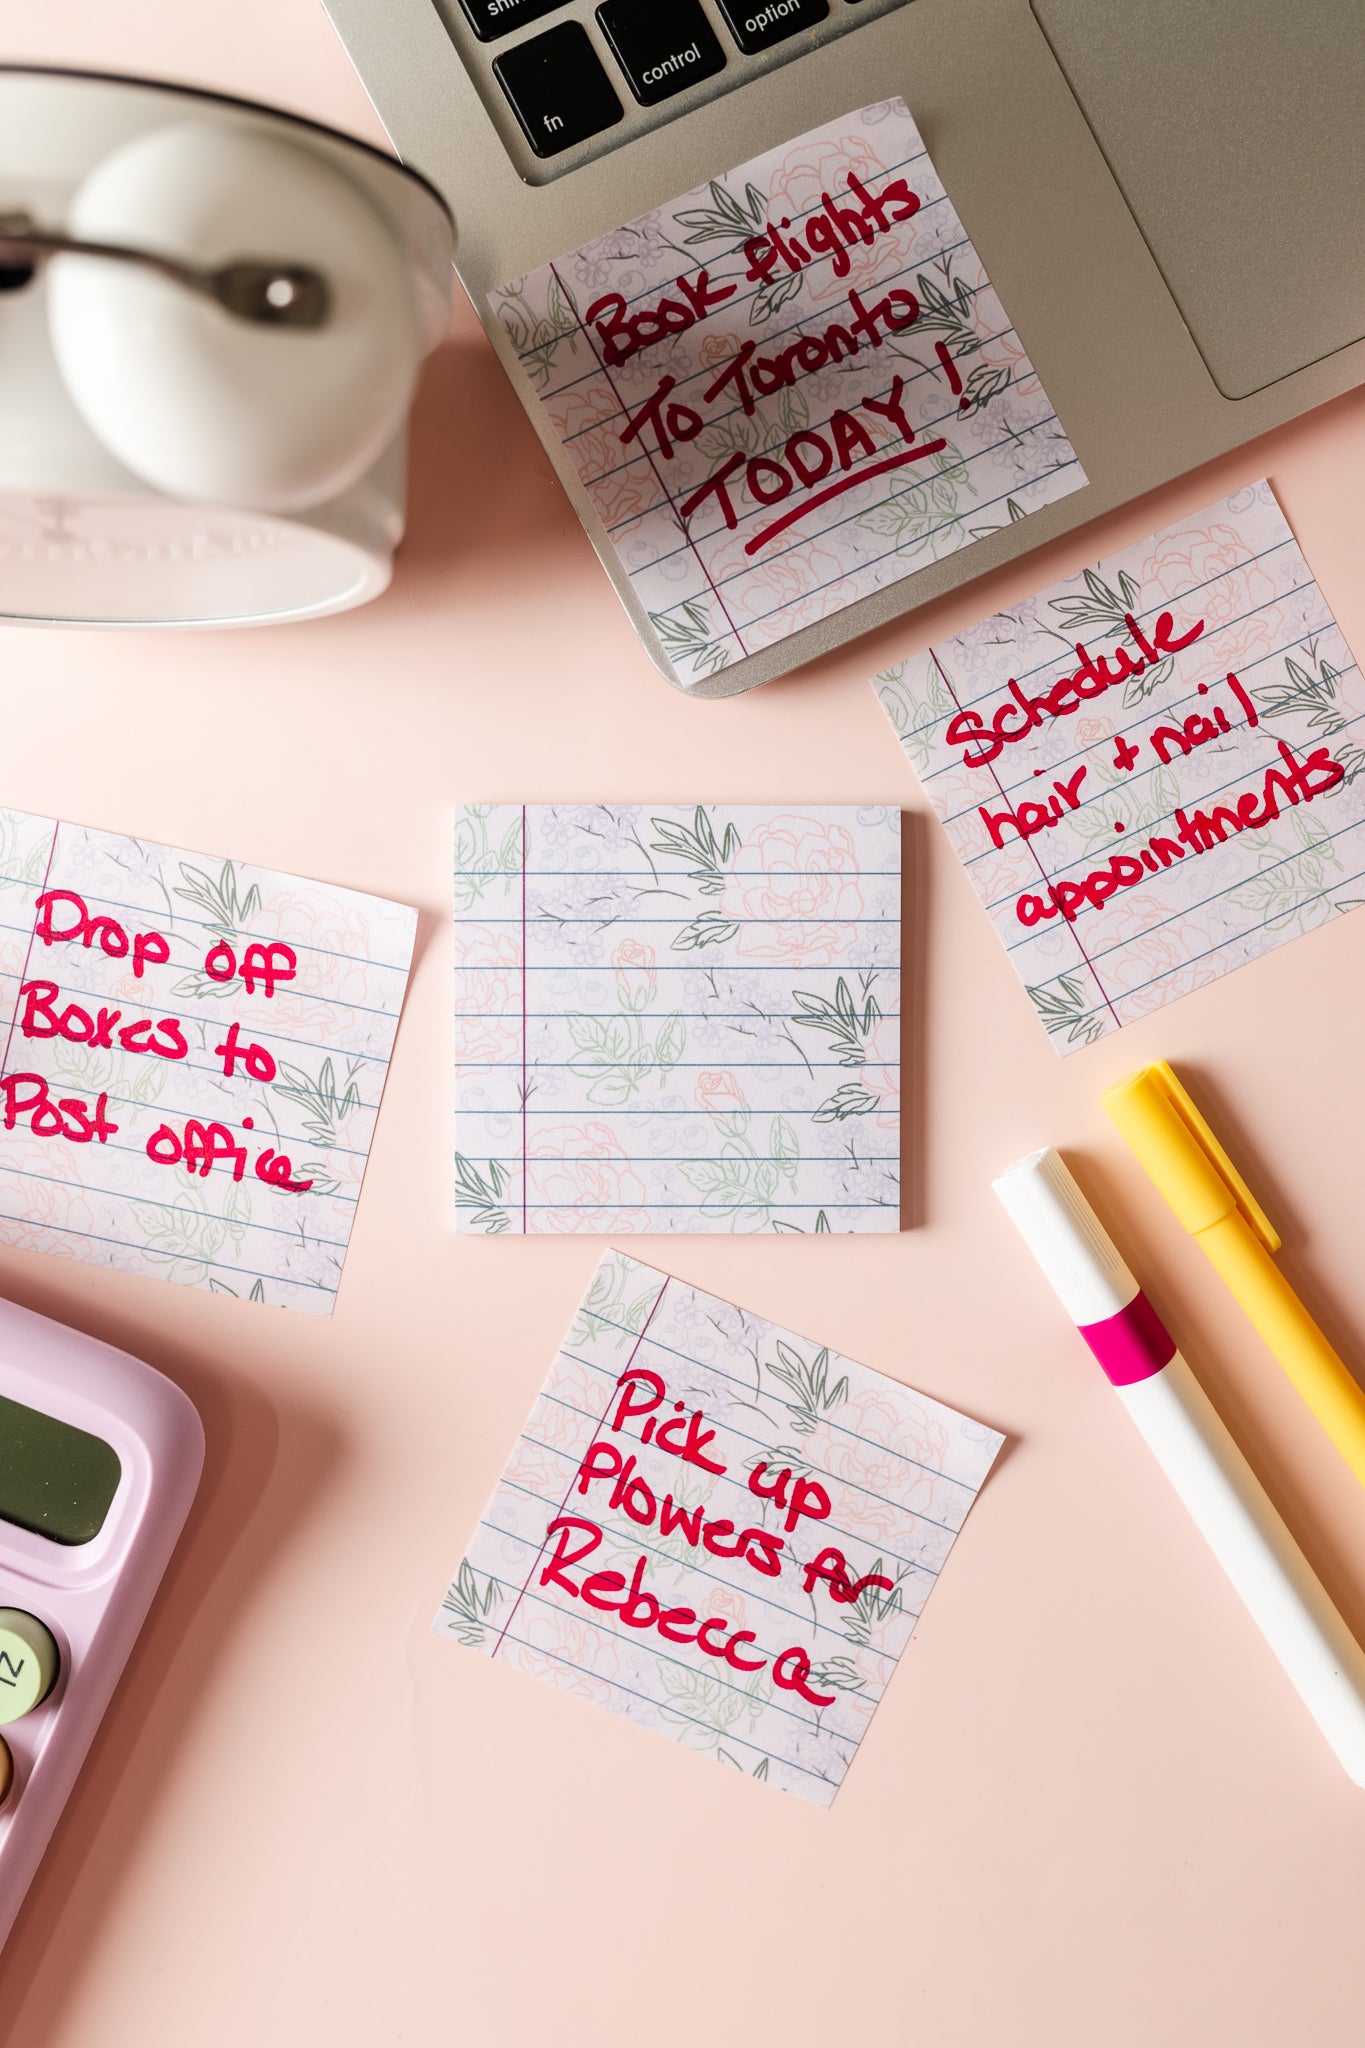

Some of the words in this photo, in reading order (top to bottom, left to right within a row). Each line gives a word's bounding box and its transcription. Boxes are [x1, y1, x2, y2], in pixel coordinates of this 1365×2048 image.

[642, 42, 701, 85] control
[745, 0, 801, 32] option
[543, 114, 564, 134] fn
[586, 270, 737, 367] Book
[703, 289, 920, 416] Toronto
[681, 375, 916, 530] TODAY
[946, 612, 1204, 768] Schedule
[978, 765, 1087, 850] hair
[1150, 673, 1259, 765] nail
[1016, 741, 1345, 927] appointments
[35, 889, 170, 978] Drop
[205, 939, 297, 998] off
[19, 979, 188, 1060] Boxes
[215, 1022, 276, 1082] to
[0, 1072, 119, 1144] Post
[616, 1368, 727, 1475] Pick
[748, 1462, 832, 1532] up
[540, 1516, 836, 1707] Rebecca
[803, 1547, 894, 1604] for
